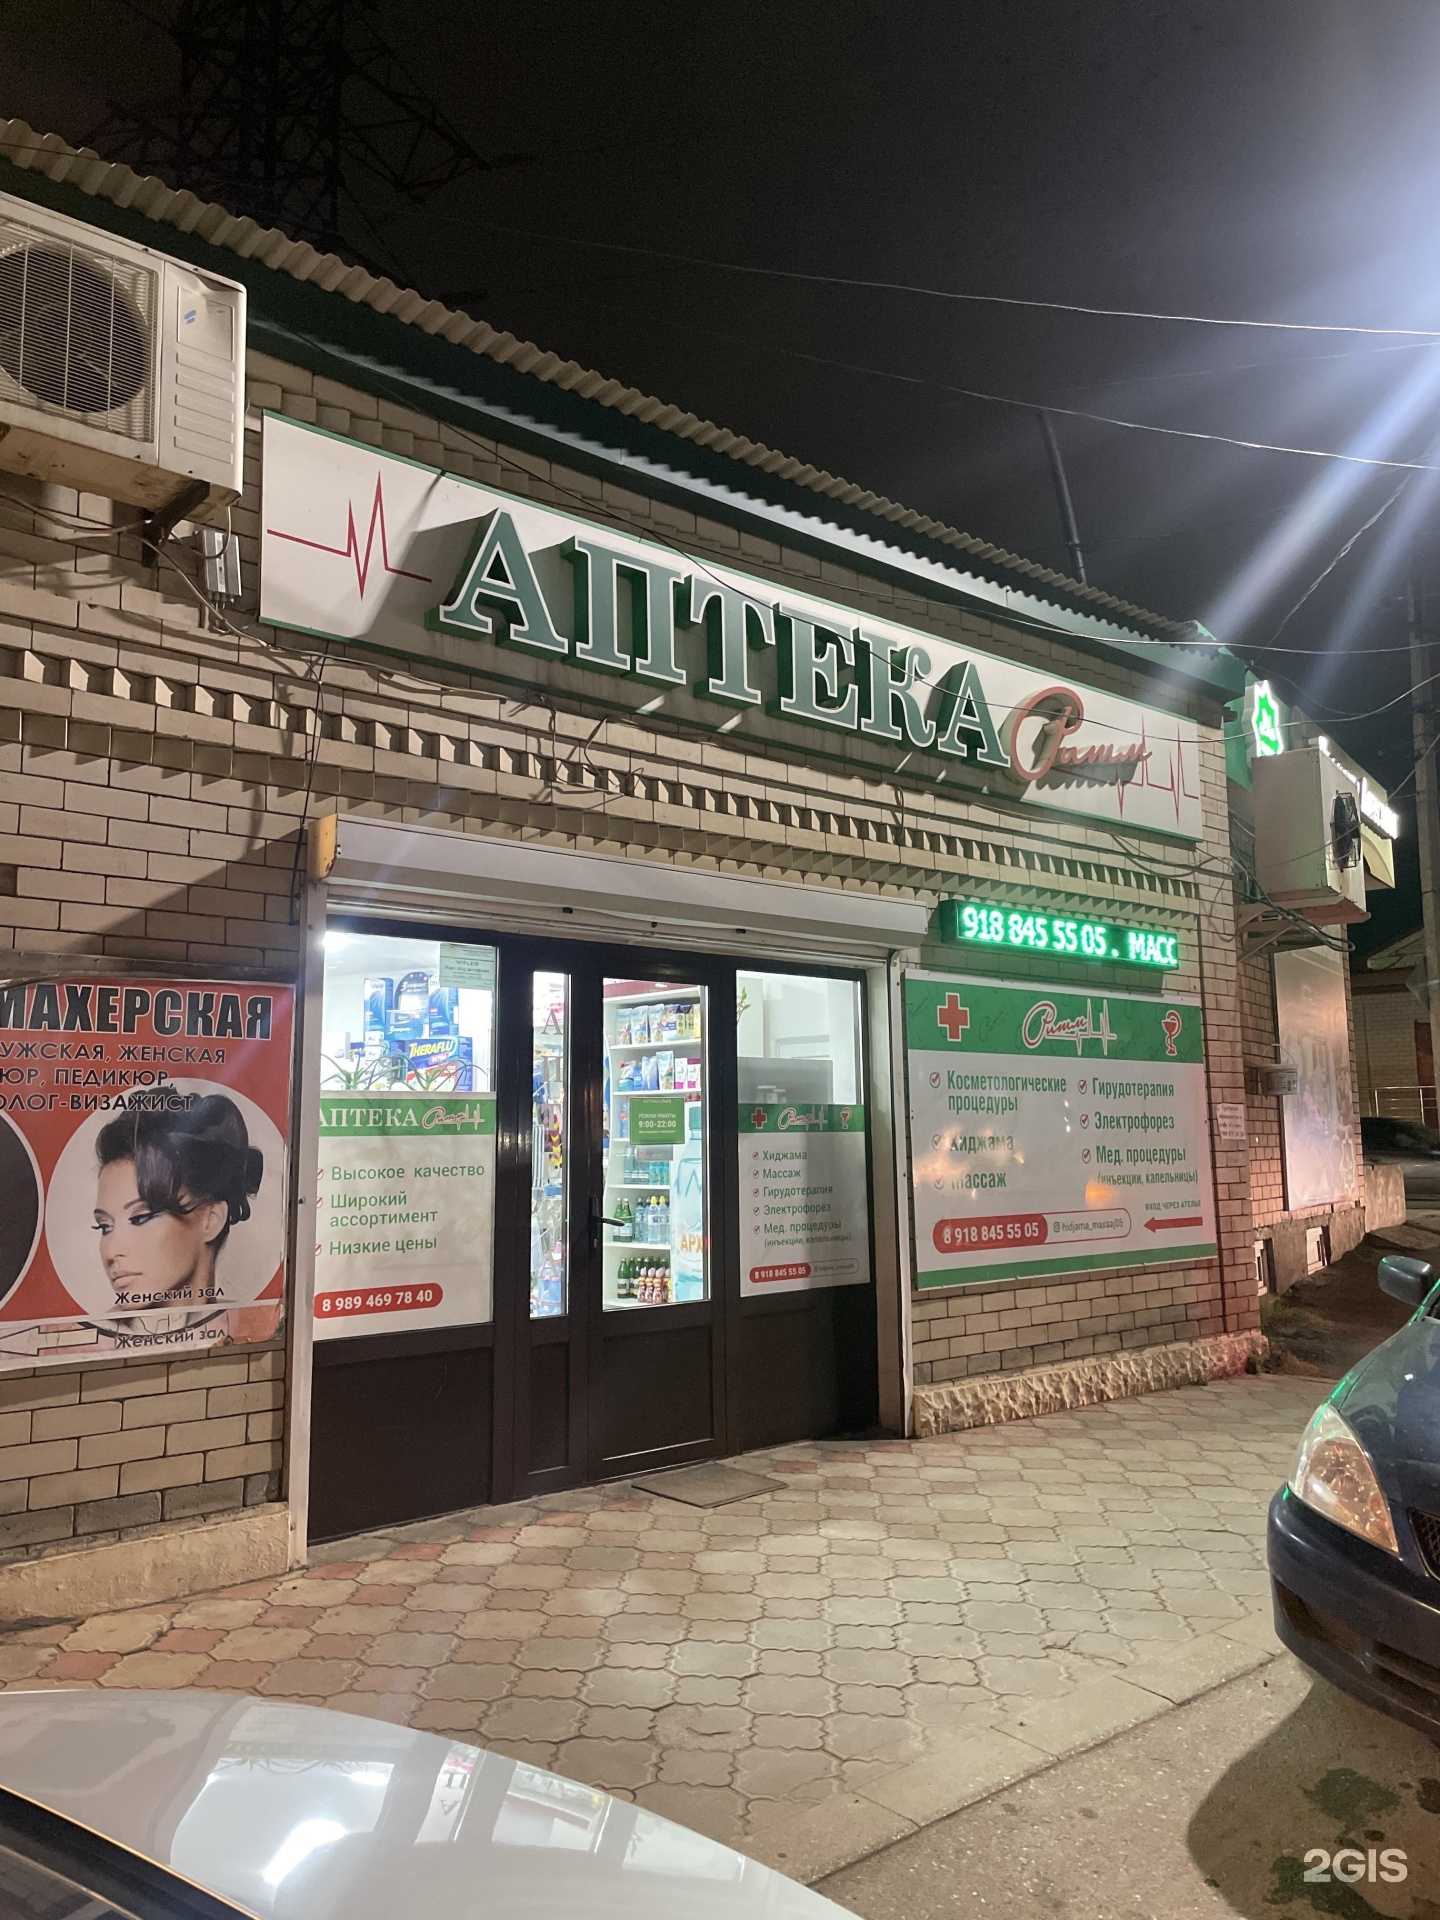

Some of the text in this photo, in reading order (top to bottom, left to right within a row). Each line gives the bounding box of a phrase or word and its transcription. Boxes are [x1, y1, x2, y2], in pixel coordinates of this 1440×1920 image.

[434, 507, 1012, 770] АПТЕКА
[962, 907, 1004, 942] 918
[1008, 913, 1048, 947] 845
[1053, 919, 1078, 952] 55
[1022, 1001, 1090, 1049] Ритм
[119, 1044, 226, 1065] ЖЕНСКАЯ
[55, 1068, 175, 1089] ПЕДИКЮР,
[947, 1071, 1067, 1093] Косметологические
[1092, 1078, 1175, 1100] Гирудотерапия
[948, 1095, 1018, 1115] процедуры
[1094, 1111, 1175, 1134] Электрофорез
[762, 1150, 808, 1161] Хиджама
[1095, 1147, 1187, 1167] Мед. процедуры
[331, 1163, 485, 1181] Высокое качество
[762, 1168, 801, 1179] Массаж
[1145, 1170, 1198, 1185] капельницы)
[330, 1191, 407, 1211] Широкий
[763, 1185, 833, 1199] Гирудотерапия
[330, 1210, 438, 1228] ассортимент
[763, 1202, 831, 1217] Электрофорез
[789, 1220, 842, 1233] процедуры
[943, 1220, 1039, 1244] 8 918 845 55 05
[330, 1237, 437, 1255] Низкие цены
[115, 1285, 225, 1304] Женский зал
[322, 1289, 433, 1311] 8 989 469 78 40
[116, 1328, 226, 1349] Женский зал
